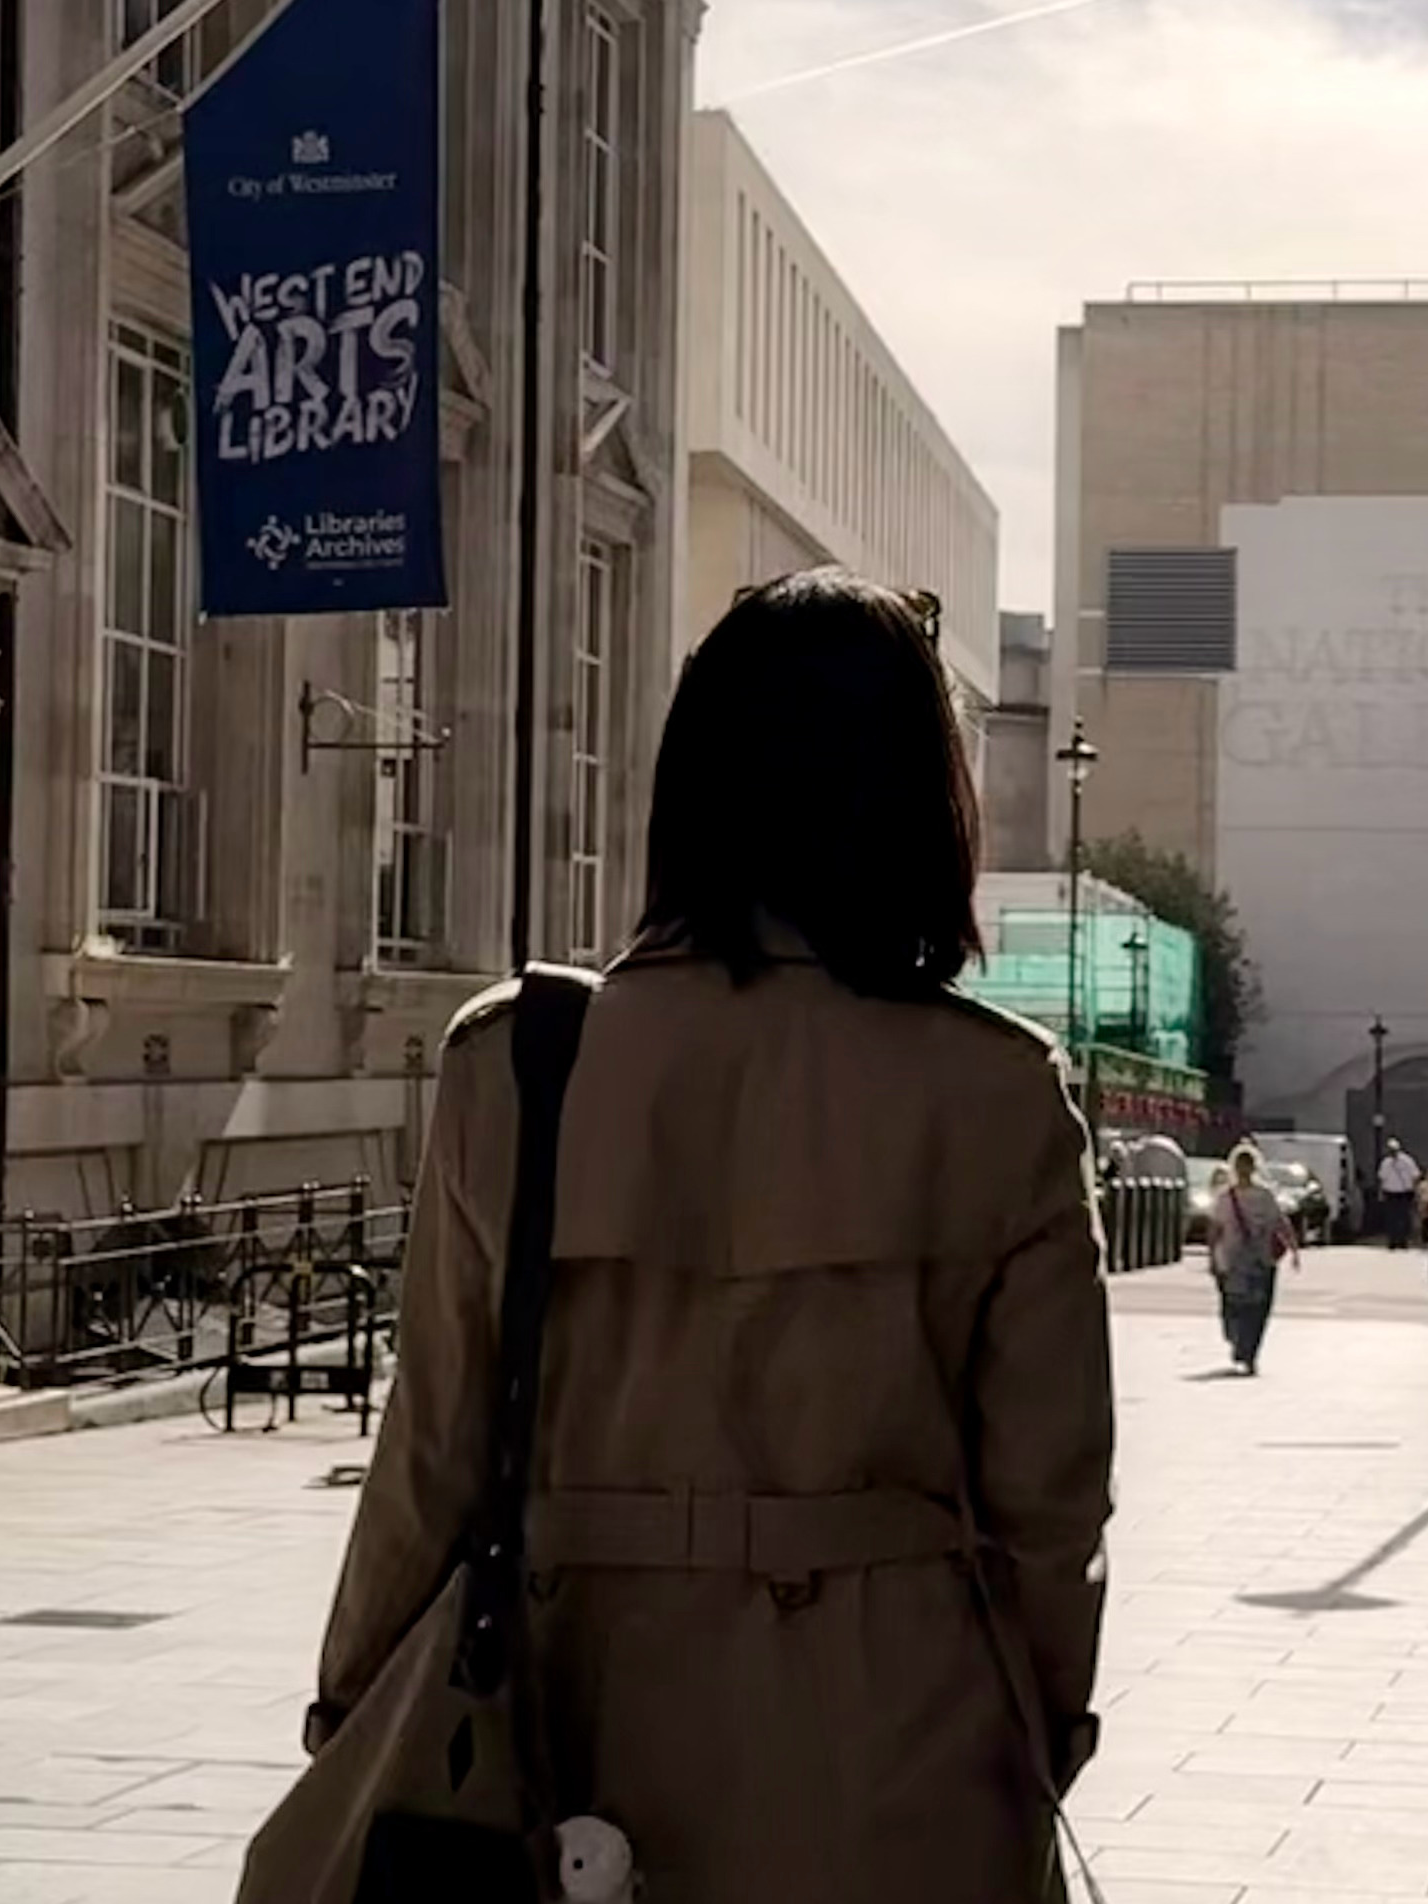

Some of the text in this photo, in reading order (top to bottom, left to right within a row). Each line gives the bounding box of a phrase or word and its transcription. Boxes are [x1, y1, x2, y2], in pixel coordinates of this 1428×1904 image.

[227, 170, 398, 203] City of Westminster
[211, 250, 423, 341] WEST END
[213, 299, 420, 413] ARTS
[218, 373, 418, 463] LIBRARY
[305, 510, 406, 535] Libraries
[305, 533, 406, 558] Archives
